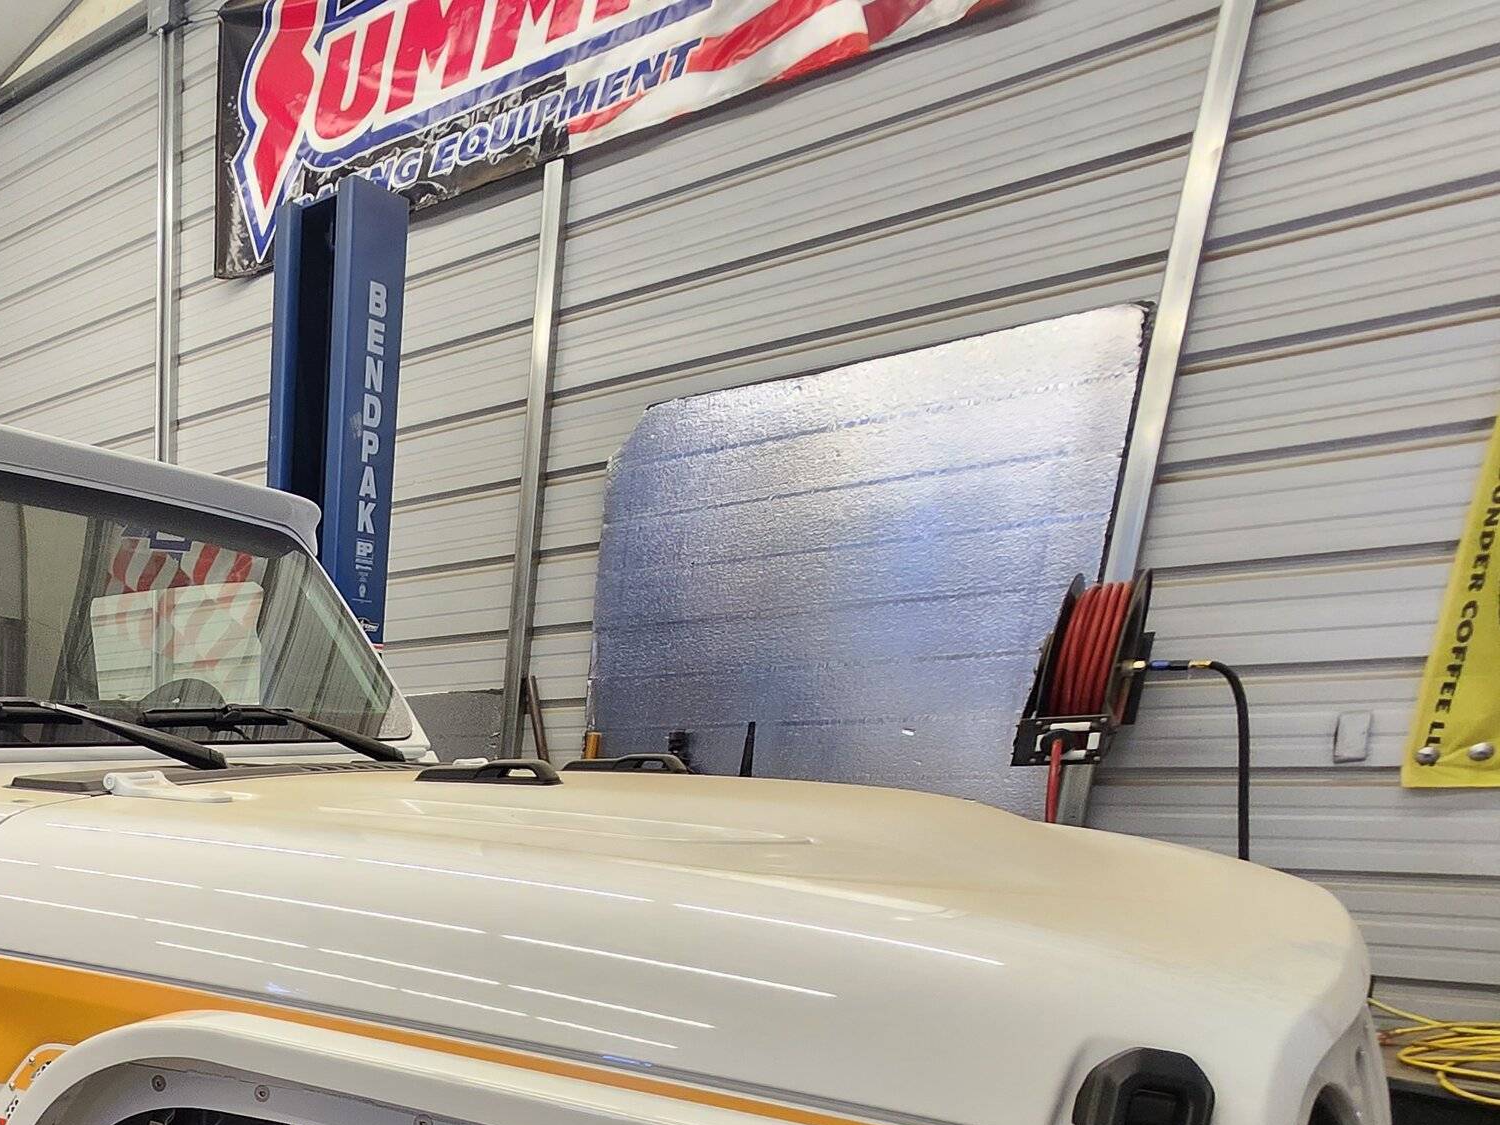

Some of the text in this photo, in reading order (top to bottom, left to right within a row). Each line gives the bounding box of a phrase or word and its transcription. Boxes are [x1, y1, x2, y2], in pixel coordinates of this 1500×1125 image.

[431, 36, 702, 176] EQUIPMENT
[357, 280, 388, 534] BENDPAK
[1435, 600, 1478, 713] COFFEE
